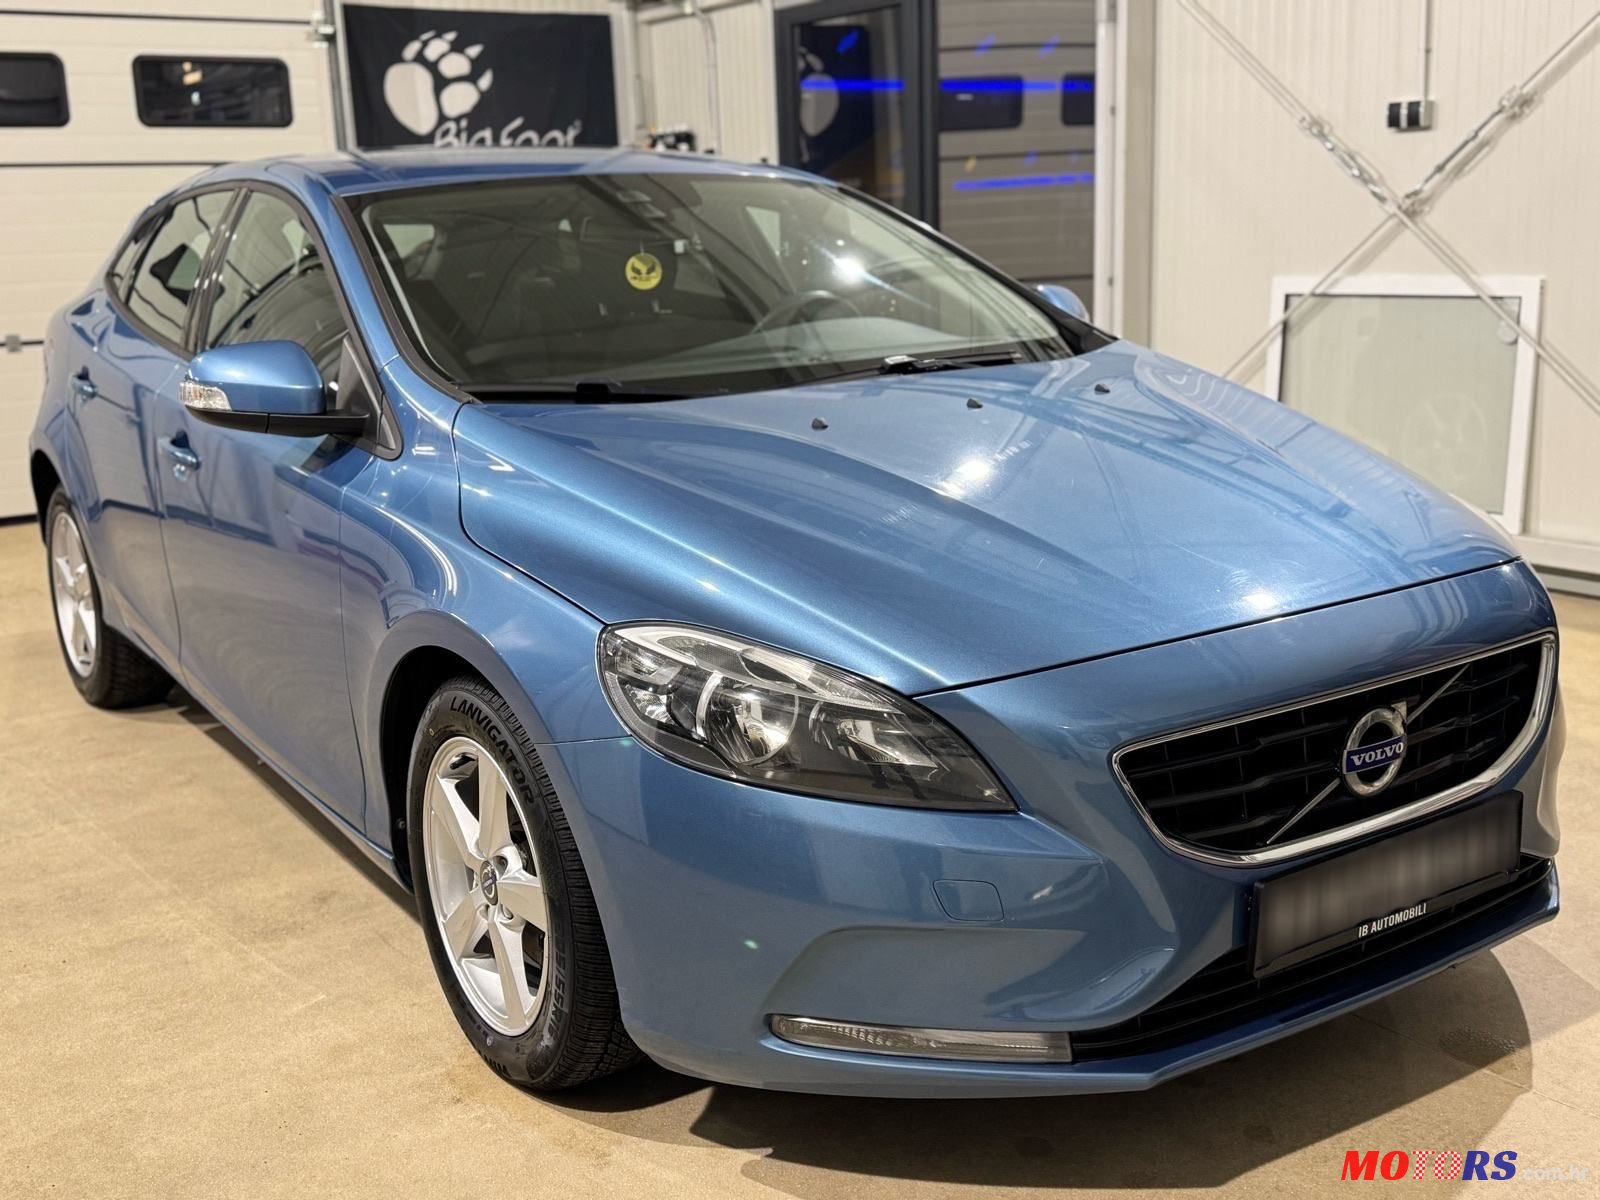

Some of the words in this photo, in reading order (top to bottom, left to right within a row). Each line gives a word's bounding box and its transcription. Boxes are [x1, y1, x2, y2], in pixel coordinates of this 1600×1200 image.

[449, 696, 535, 804] LANVIGATOR
[1350, 741, 1405, 766] VOLVO
[1358, 924, 1369, 938] IB
[1370, 902, 1427, 934] AUTOMOBILI
